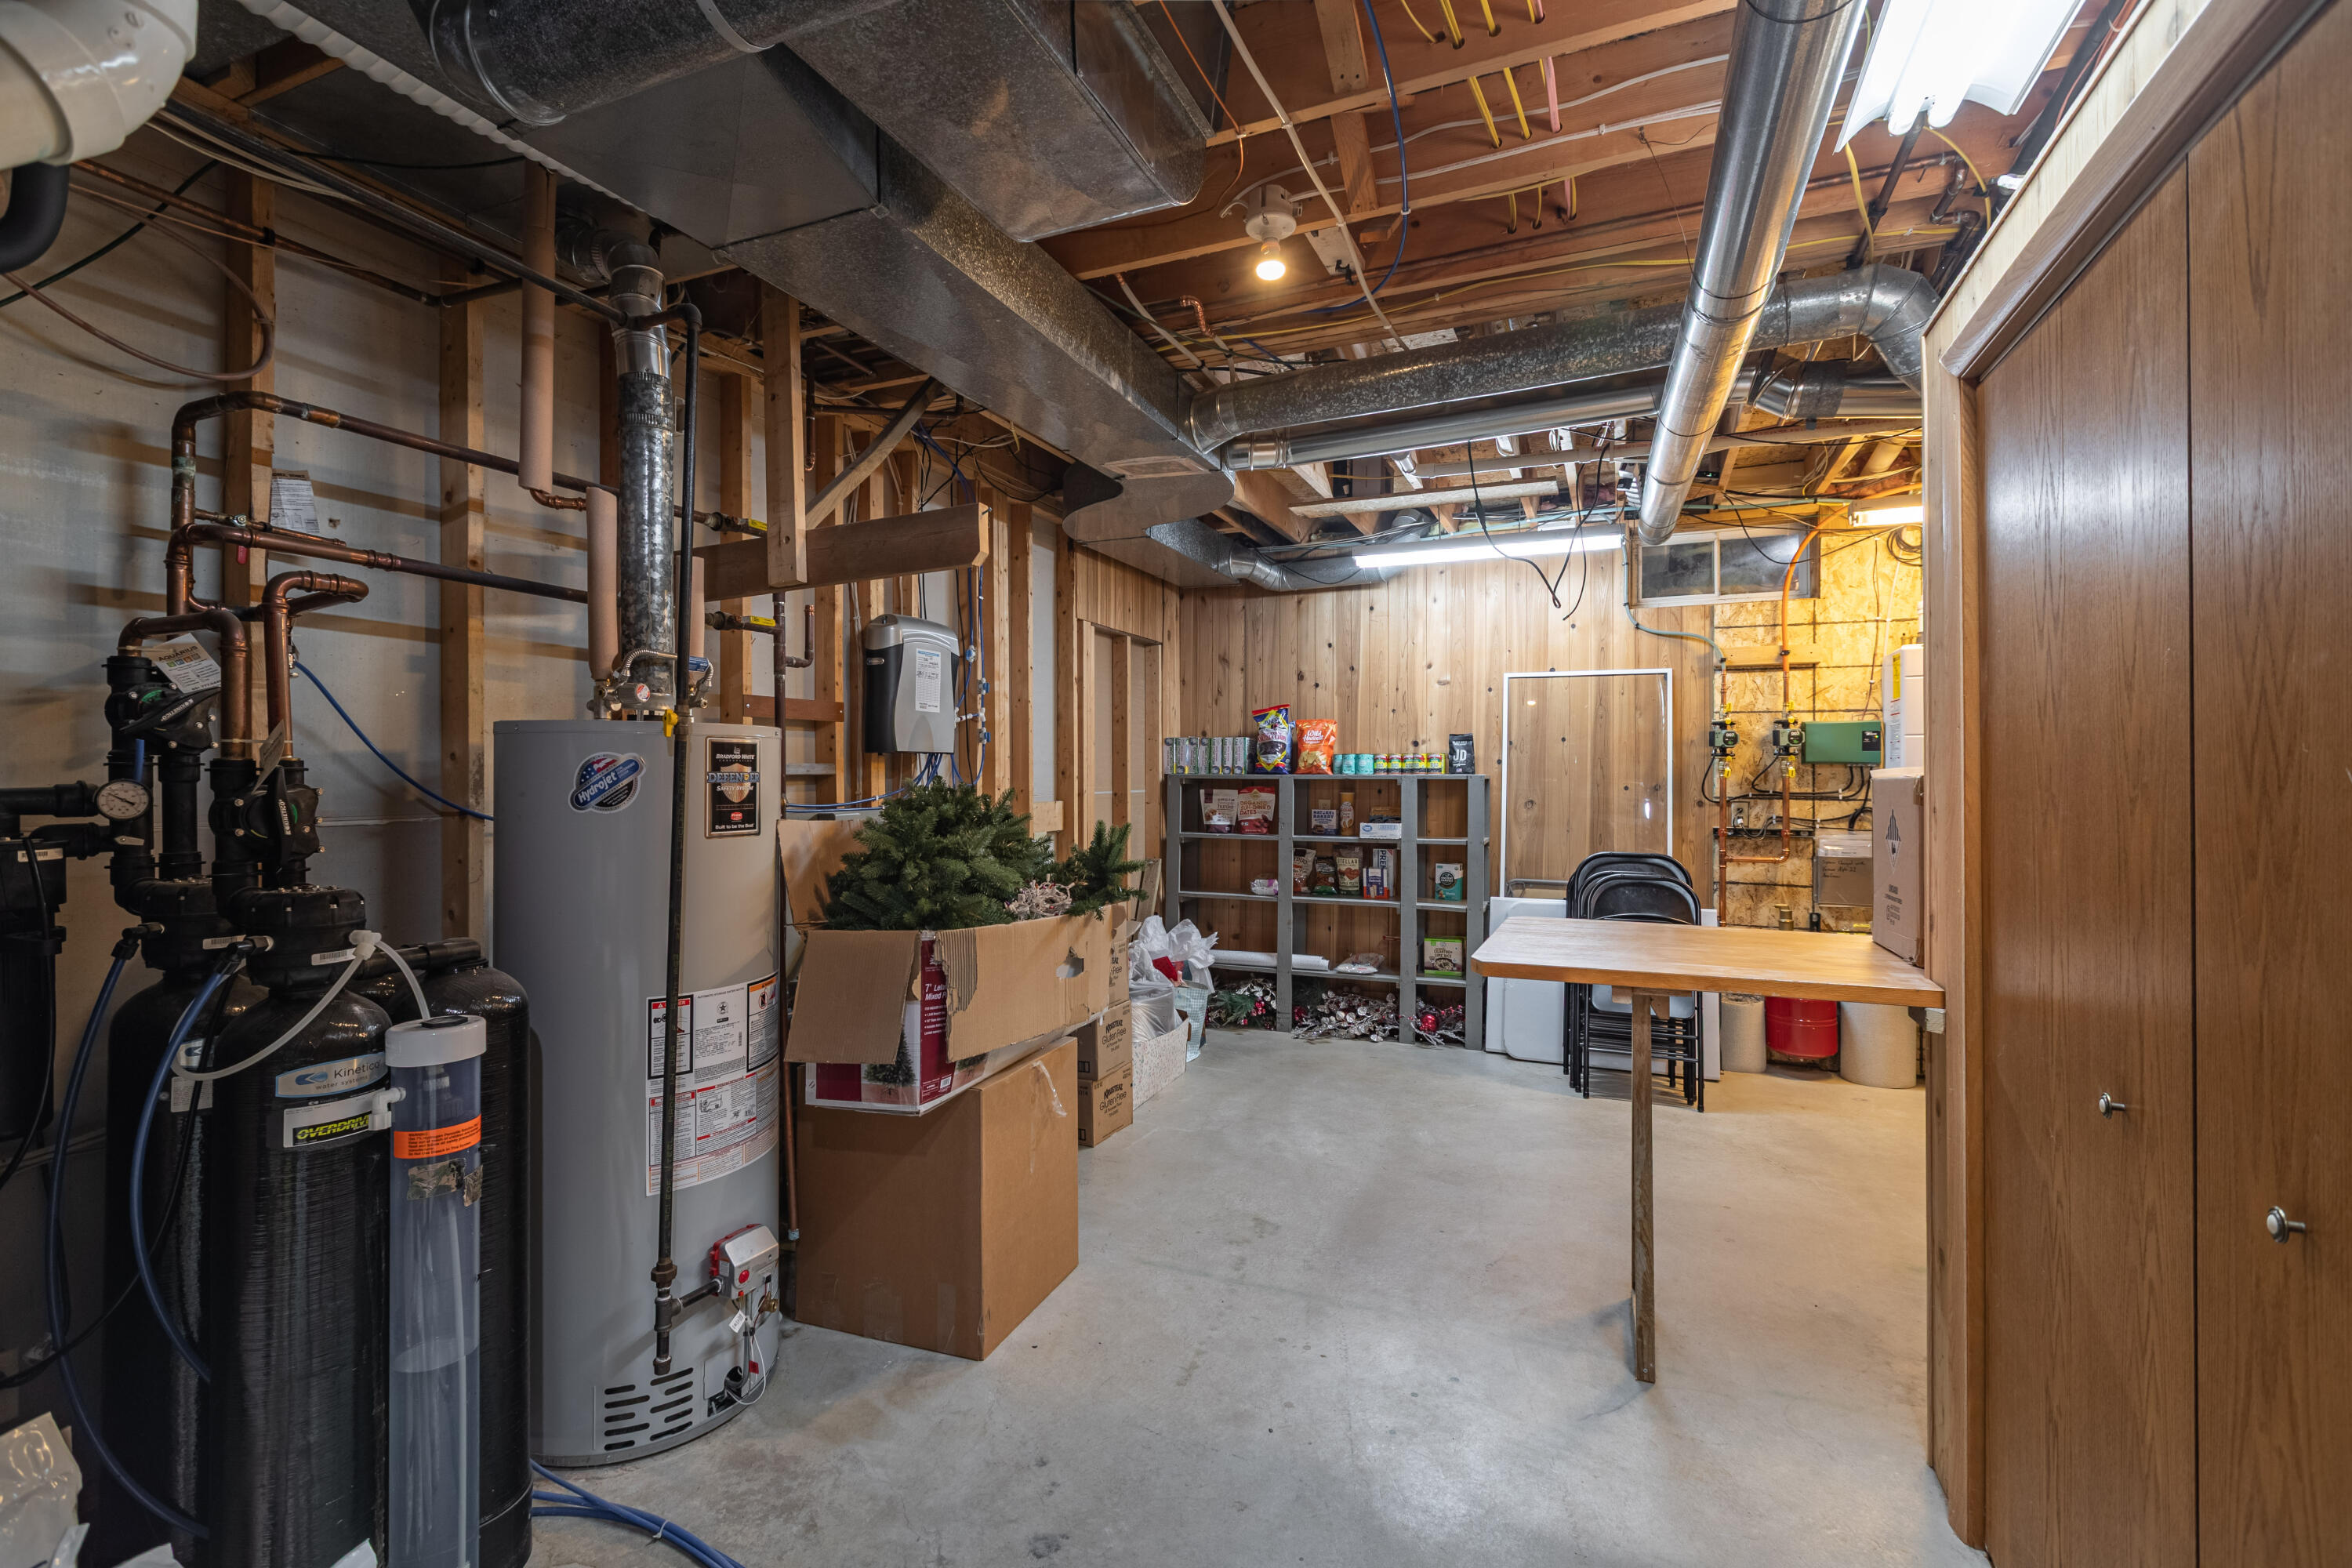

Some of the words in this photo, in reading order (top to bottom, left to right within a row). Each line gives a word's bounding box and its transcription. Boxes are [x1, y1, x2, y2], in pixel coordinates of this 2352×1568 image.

[158, 646, 198, 662] AQUARIUS
[1453, 749, 1467, 761] JD
[708, 772, 760, 783] DEFENDER
[578, 771, 618, 803] Hydrojet
[925, 992, 942, 1001] Mixed
[1105, 1019, 1123, 1034] KRUSTEAZ
[1102, 1032, 1117, 1045] Gluten
[1117, 1027, 1127, 1037] Free
[334, 1062, 380, 1079] Kinetico
[315, 1082, 338, 1091] water
[341, 1076, 368, 1086] systems
[1104, 1083, 1123, 1100] KRUSTEAZ
[1099, 1097, 1116, 1111] Gluten
[1116, 1091, 1127, 1101] Free
